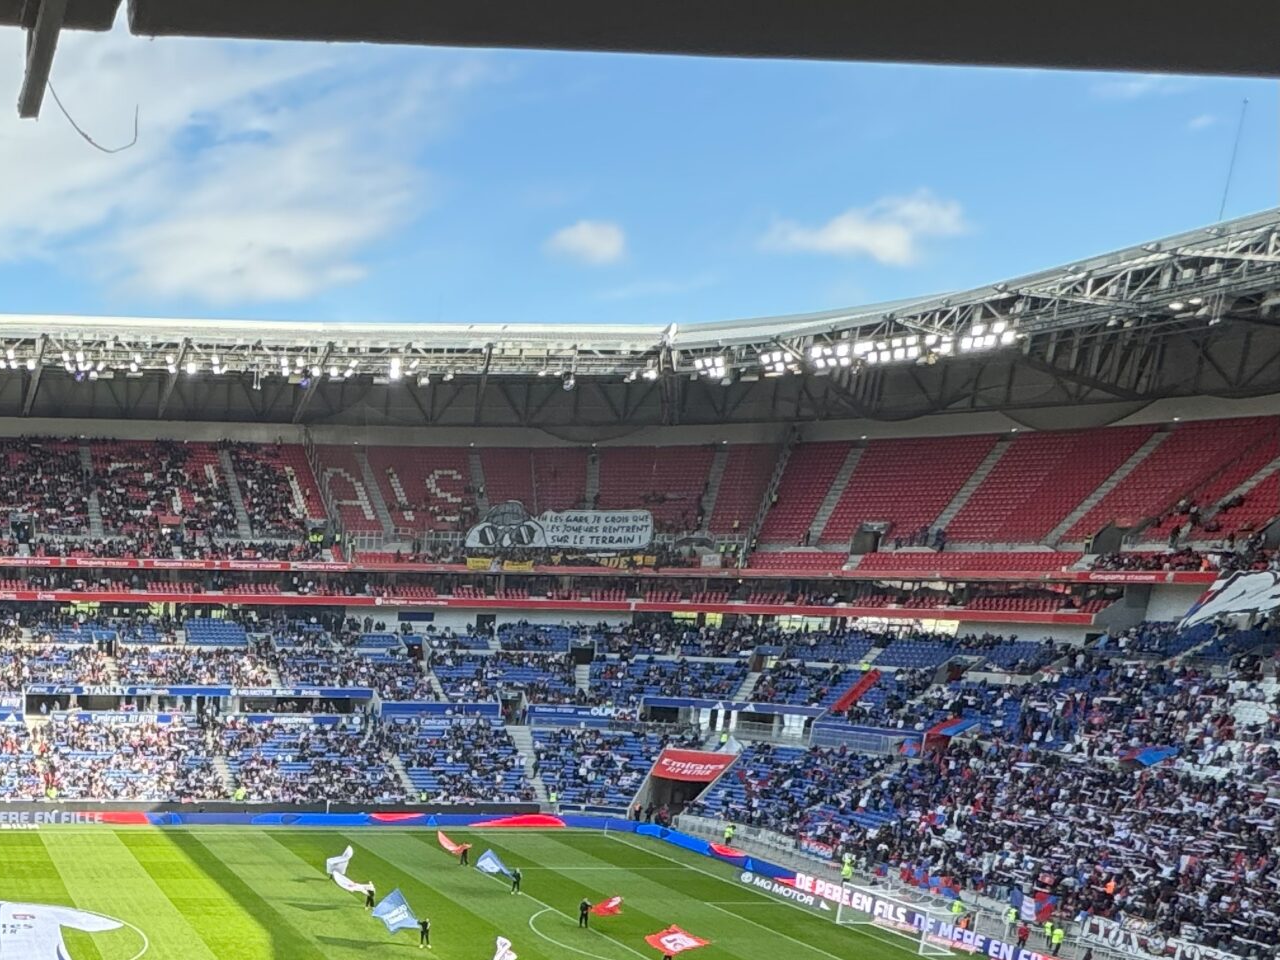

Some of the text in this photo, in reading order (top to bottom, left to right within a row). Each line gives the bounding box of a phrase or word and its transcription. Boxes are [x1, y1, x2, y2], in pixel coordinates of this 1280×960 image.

[633, 515, 649, 523] QUE
[563, 525, 599, 533] JOUEURS
[602, 524, 650, 533] RENTRENT
[551, 535, 569, 544] SUR
[573, 535, 585, 544] LE
[589, 534, 636, 544] TERRAIN
[82, 685, 129, 696] STANLEY
[91, 713, 127, 723] Emirates
[661, 757, 724, 772] Emirates
[34, 811, 56, 823] EN
[60, 811, 104, 824] FILLE
[753, 877, 815, 906] MG MOTOR
[795, 873, 814, 893] DE
[851, 894, 874, 913] EN
